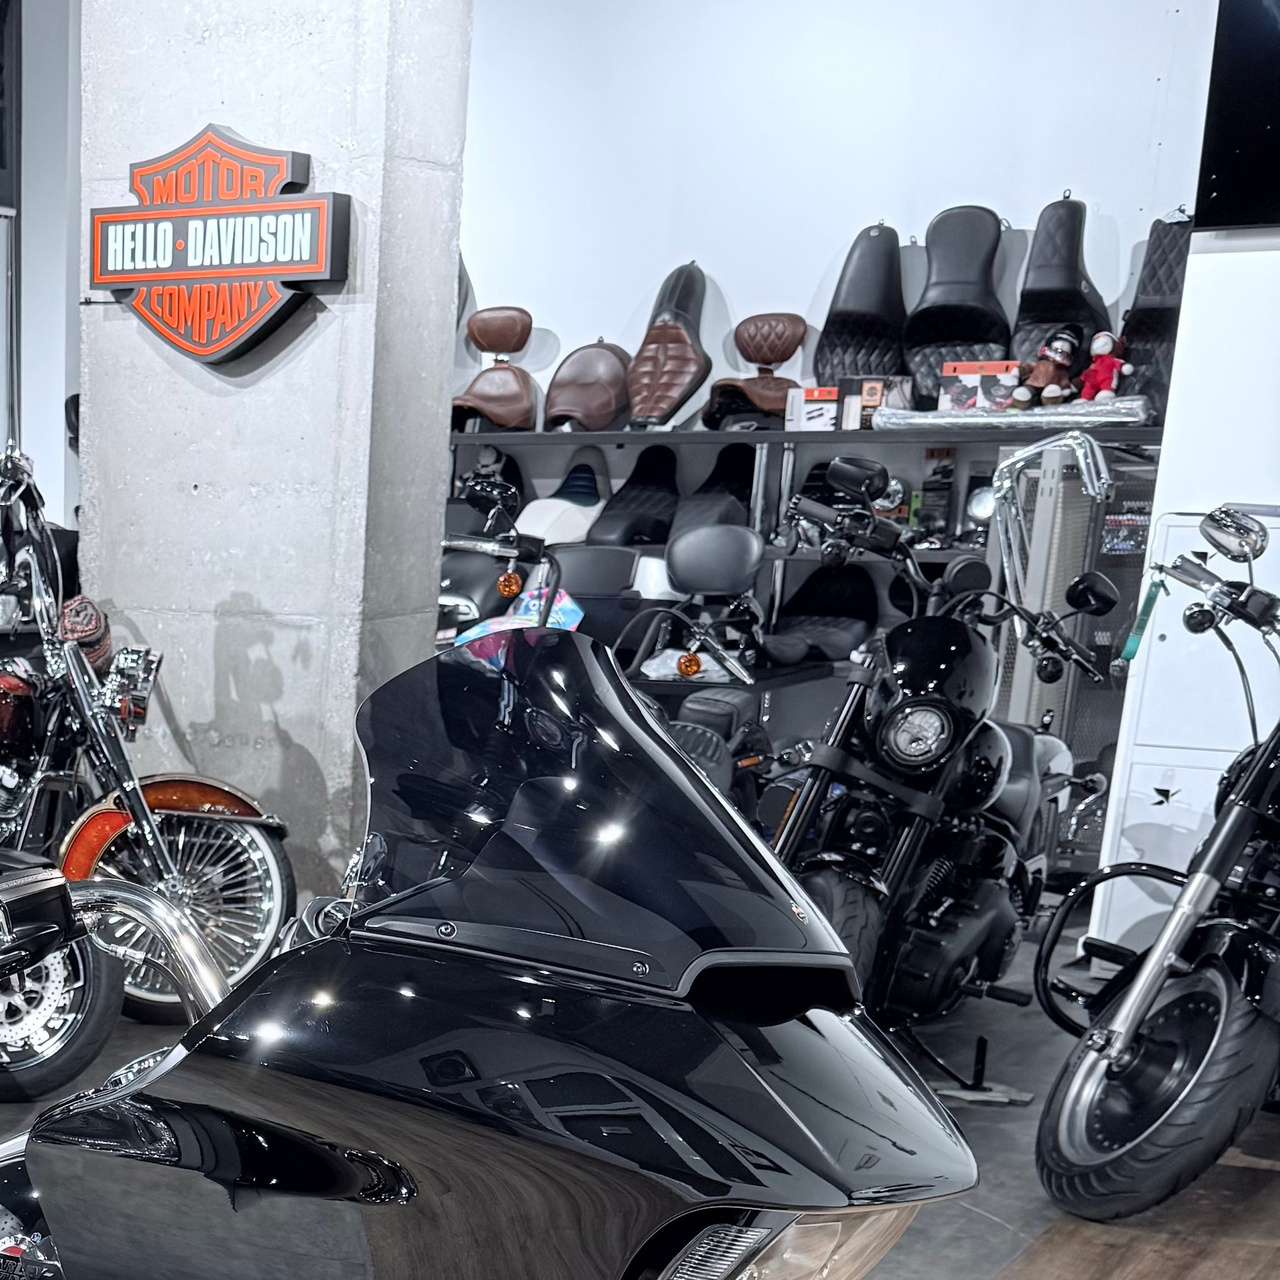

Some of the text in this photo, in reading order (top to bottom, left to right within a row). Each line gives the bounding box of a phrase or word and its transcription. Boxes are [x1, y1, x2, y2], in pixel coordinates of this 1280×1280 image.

[153, 147, 265, 204] MOTOR
[107, 212, 312, 271] HELLO DAVIDSON
[150, 281, 263, 343] COMPANY
